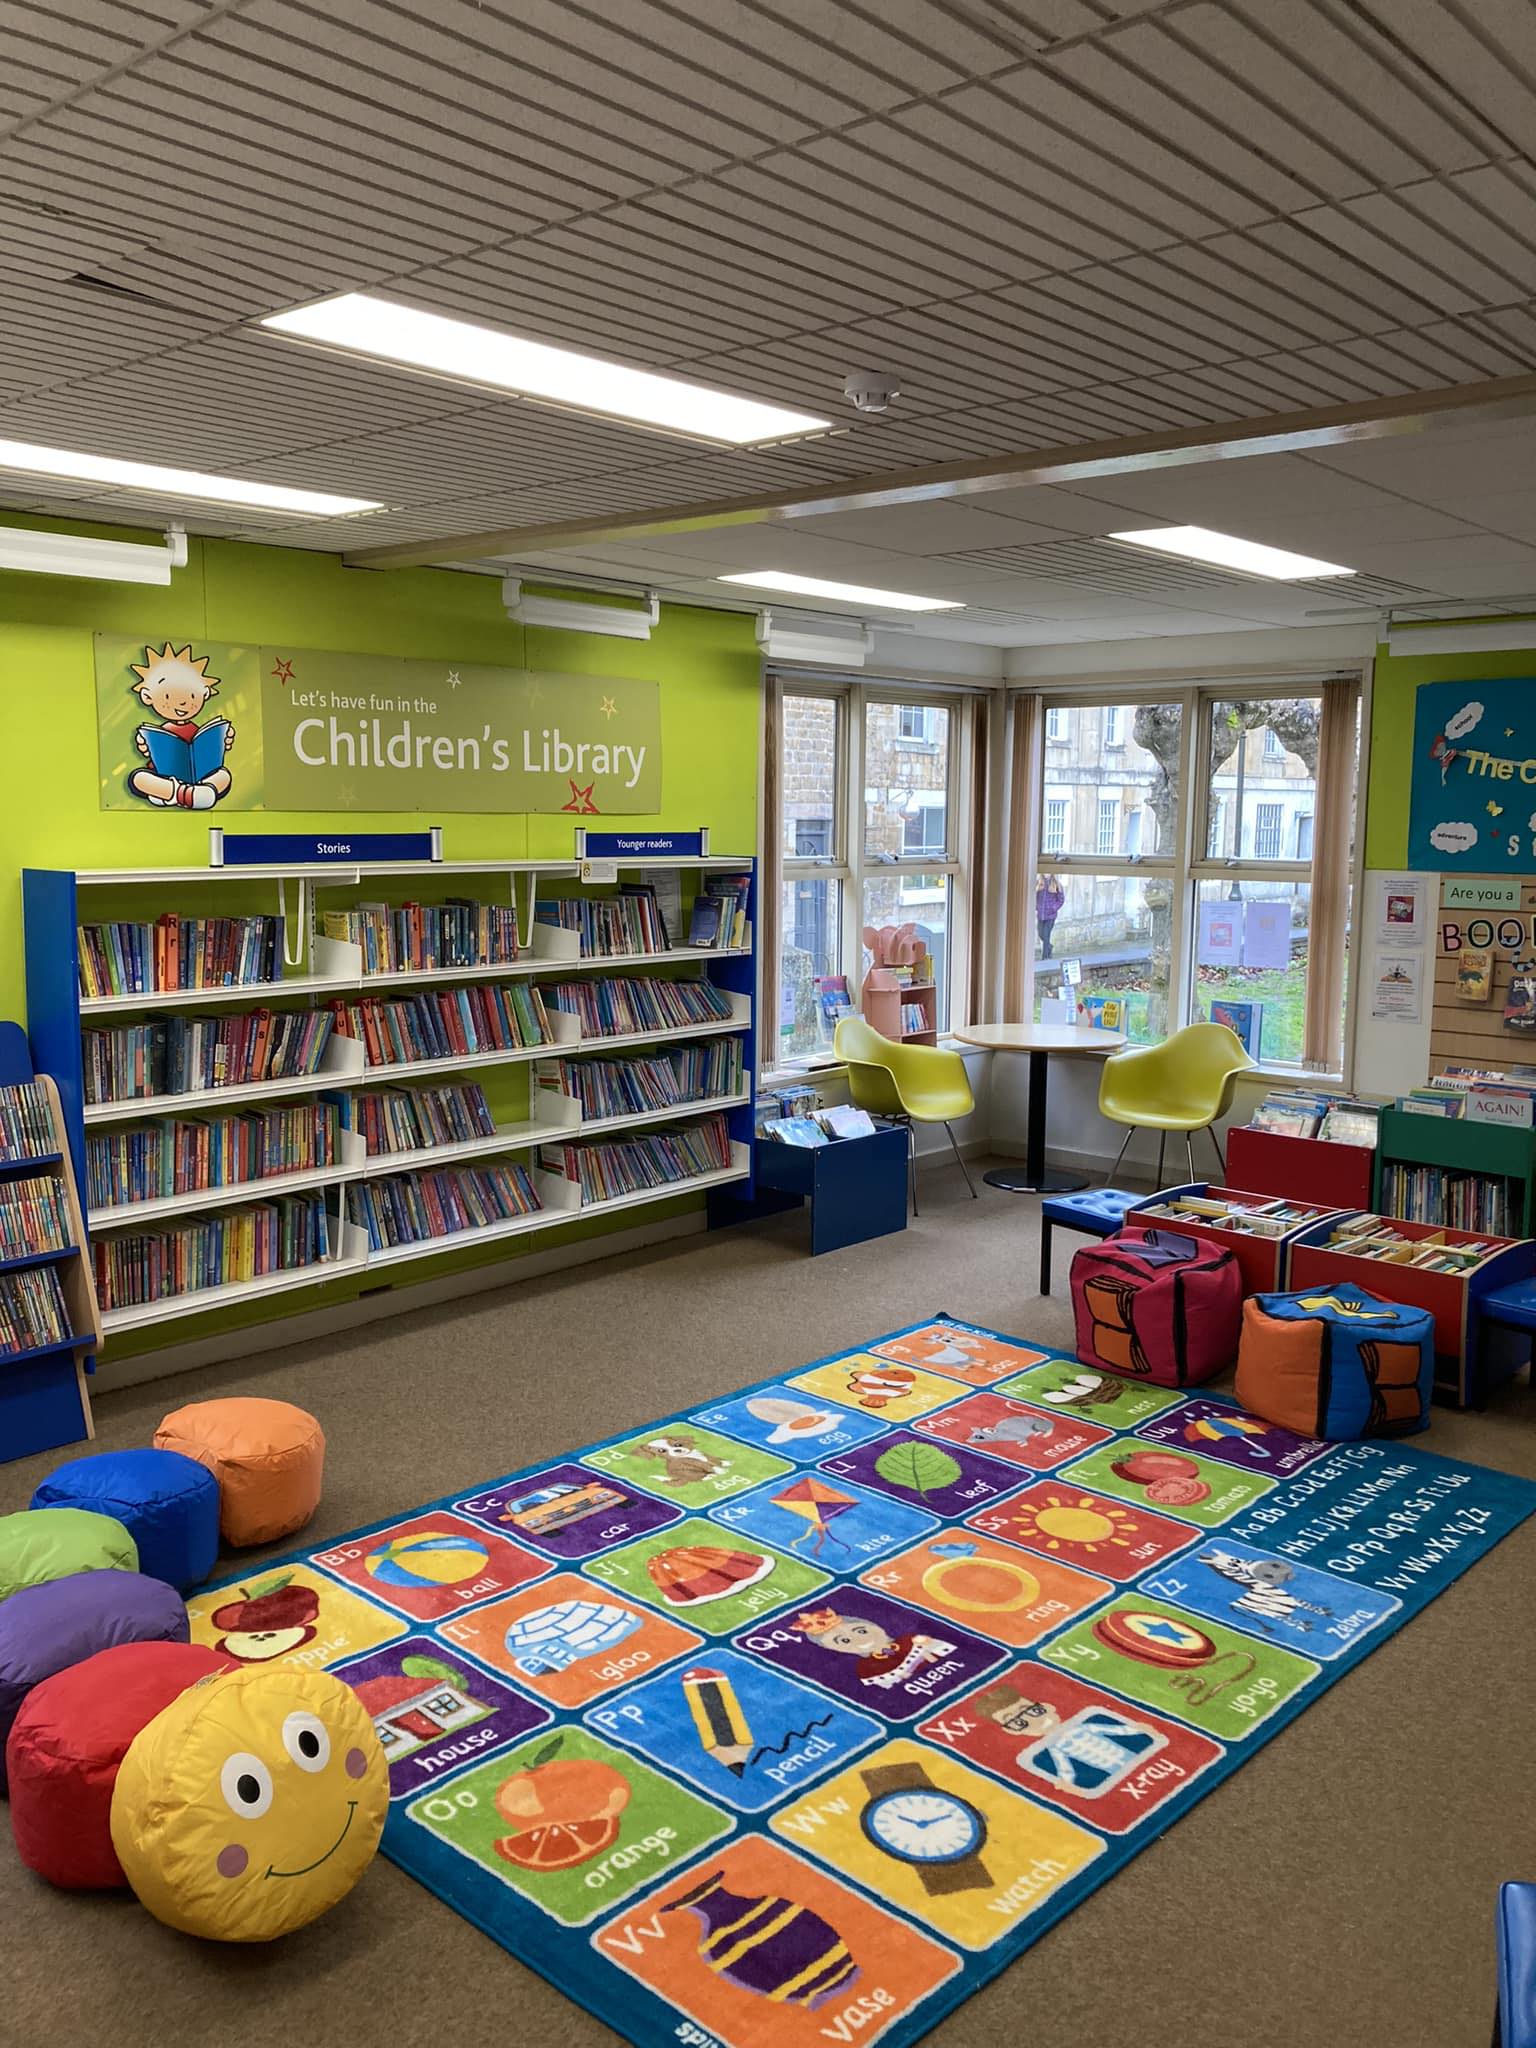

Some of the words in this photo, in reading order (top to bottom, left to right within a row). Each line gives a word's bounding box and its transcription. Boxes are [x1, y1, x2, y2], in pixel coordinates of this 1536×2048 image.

[291, 689, 327, 707] Let's
[331, 691, 366, 709] have
[369, 694, 394, 711] fun
[397, 696, 411, 713] in
[413, 697, 438, 714] the
[293, 716, 510, 771] Children's
[523, 729, 646, 788] Library
[1466, 750, 1514, 780] The
[316, 842, 351, 854] Stories
[617, 839, 646, 851] Younger
[647, 838, 673, 849] readers
[1450, 887, 1474, 899] Are
[1477, 890, 1502, 902] you
[1505, 891, 1514, 901] a
[168, 917, 177, 929] R
[260, 1010, 268, 1022] S
[1474, 1100, 1525, 1117] AGAIN!
[1127, 1400, 1156, 1416] nest
[696, 1413, 729, 1428] Ee
[917, 1416, 960, 1434] Mm
[818, 1430, 853, 1446] egg
[1142, 1426, 1179, 1440] Uu
[1043, 1434, 1088, 1458] mouse
[1275, 1440, 1330, 1469] umbrella
[589, 1449, 627, 1467] Dd
[1381, 1464, 1418, 1479] Nn
[1433, 1473, 1472, 1488] Uu
[713, 1474, 752, 1492] dog
[954, 1478, 998, 1500] leaf
[1355, 1478, 1397, 1498] Mm
[1203, 1484, 1252, 1513] tomato
[1231, 1521, 1267, 1540] Aa
[1250, 1507, 1287, 1524] Bb
[1272, 1493, 1306, 1508] Cc
[1290, 1478, 1327, 1495] Dd
[1310, 1467, 1342, 1481] Ee
[1345, 1445, 1385, 1460] Gg
[1415, 1487, 1451, 1498] Tt
[463, 1498, 503, 1513] Cc
[717, 1504, 756, 1522] Kk
[1327, 1505, 1363, 1521] Kk
[1403, 1499, 1436, 1512] Ss
[973, 1515, 1010, 1531] Ss
[1311, 1516, 1350, 1531] Jj
[1388, 1510, 1421, 1525] Rr
[1455, 1507, 1492, 1524] Zz
[599, 1522, 632, 1539] car
[1297, 1528, 1330, 1542] Ii
[1368, 1523, 1417, 1540] Qq
[1440, 1521, 1487, 1536] Yy
[855, 1534, 896, 1553] kite
[1128, 1540, 1163, 1560] sun
[1277, 1540, 1317, 1557] Hh
[1346, 1540, 1392, 1557] Pp
[1424, 1535, 1462, 1553] Xx
[319, 1544, 363, 1567] Bb
[1327, 1555, 1366, 1573] Oo
[1398, 1550, 1443, 1573] Ww
[595, 1560, 630, 1576] Jj
[453, 1577, 503, 1599] ball
[867, 1571, 903, 1589] Rr
[1147, 1577, 1189, 1597] Zz
[1375, 1572, 1417, 1590] Vv
[738, 1586, 789, 1613] jelly
[1024, 1597, 1072, 1625] ring
[447, 1624, 480, 1640] Ii
[1326, 1608, 1376, 1640] zebra
[745, 1627, 803, 1653] Qq
[1049, 1642, 1101, 1664] Yy
[592, 1650, 652, 1681] igloo
[903, 1661, 965, 1697] queen
[1228, 1676, 1279, 1718] yo-yo
[594, 1703, 647, 1730] Pp
[925, 1714, 977, 1743] Xx
[413, 1727, 499, 1773] house
[764, 1735, 838, 1786] pencil
[423, 1790, 479, 1821] Oo
[780, 1796, 851, 1837] Ww
[584, 1825, 677, 1889] orange
[987, 1856, 1067, 1916] watch
[604, 1914, 667, 1955] Vv
[820, 1985, 895, 2045] vase
